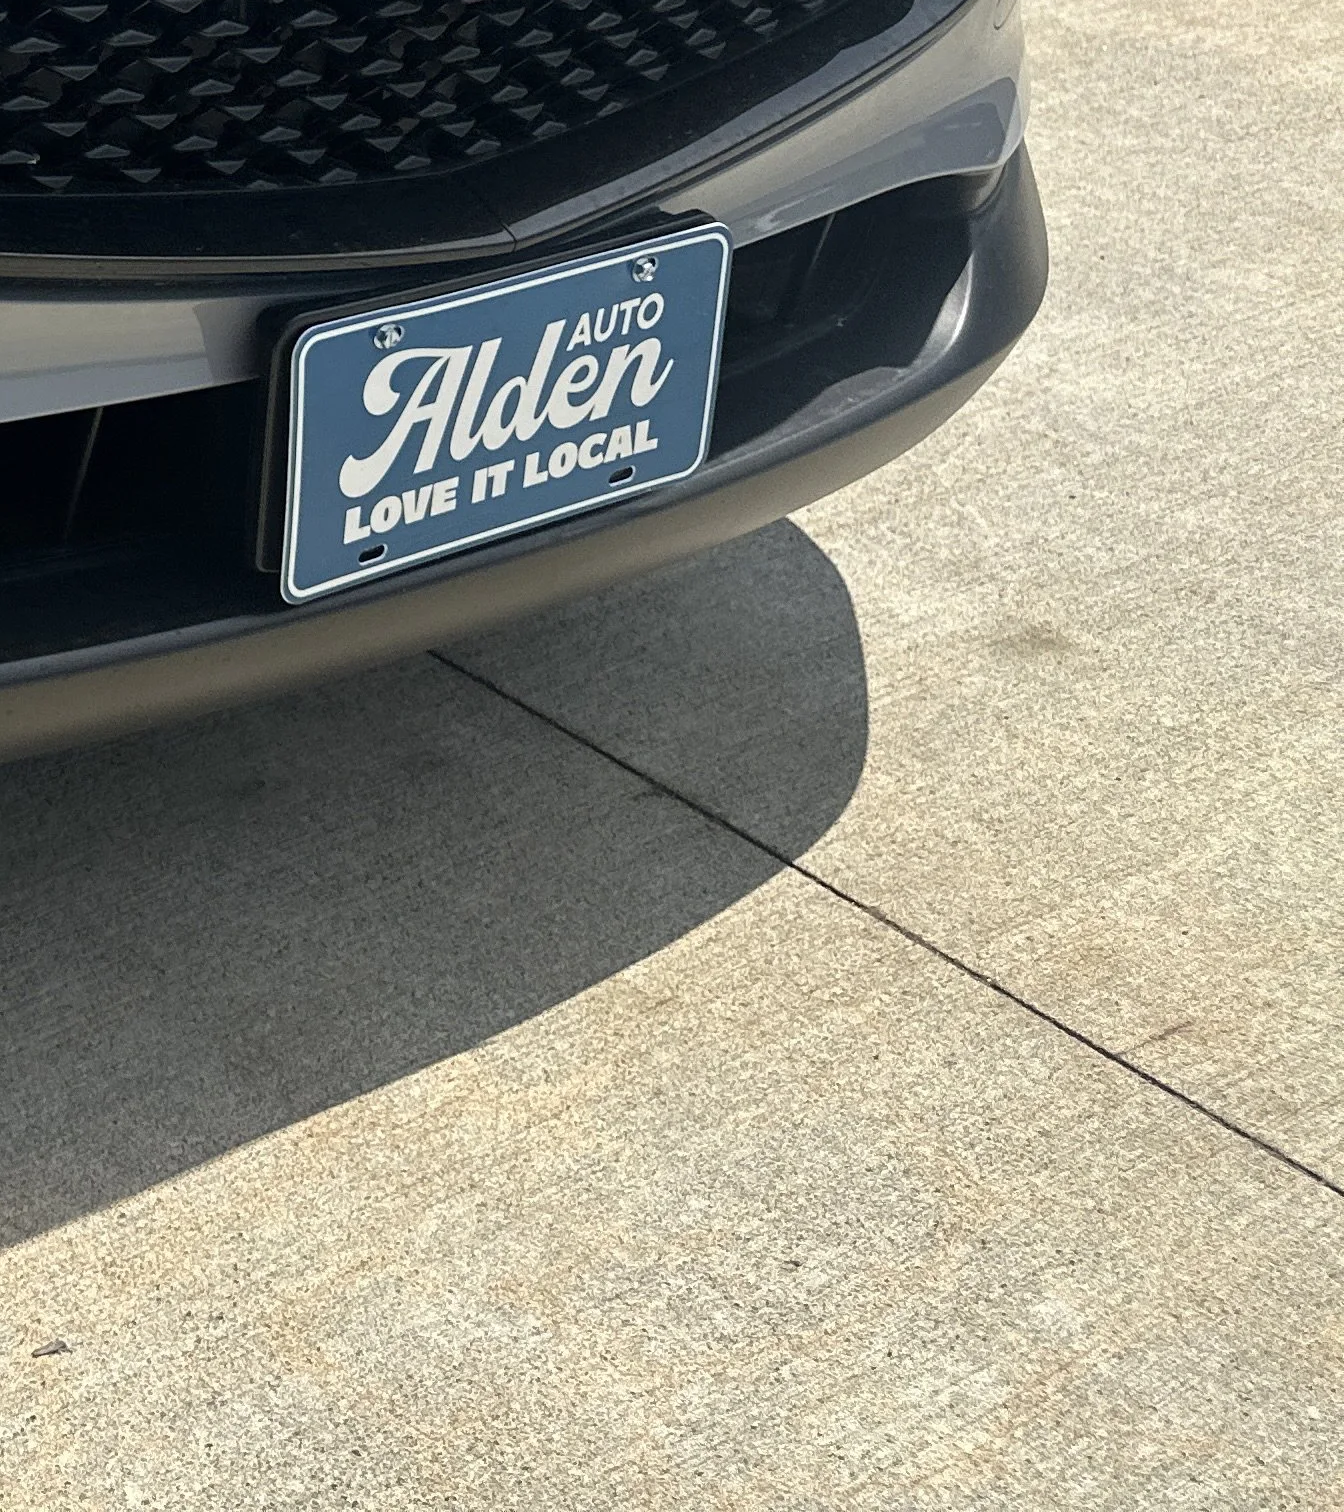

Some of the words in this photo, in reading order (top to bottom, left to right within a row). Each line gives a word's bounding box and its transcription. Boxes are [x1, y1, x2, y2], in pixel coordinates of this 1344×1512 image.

[566, 292, 665, 352] AUTO
[339, 319, 674, 498] Alden
[343, 477, 458, 545] LOVE
[471, 458, 514, 504] IT
[523, 419, 658, 489] LOCAL
